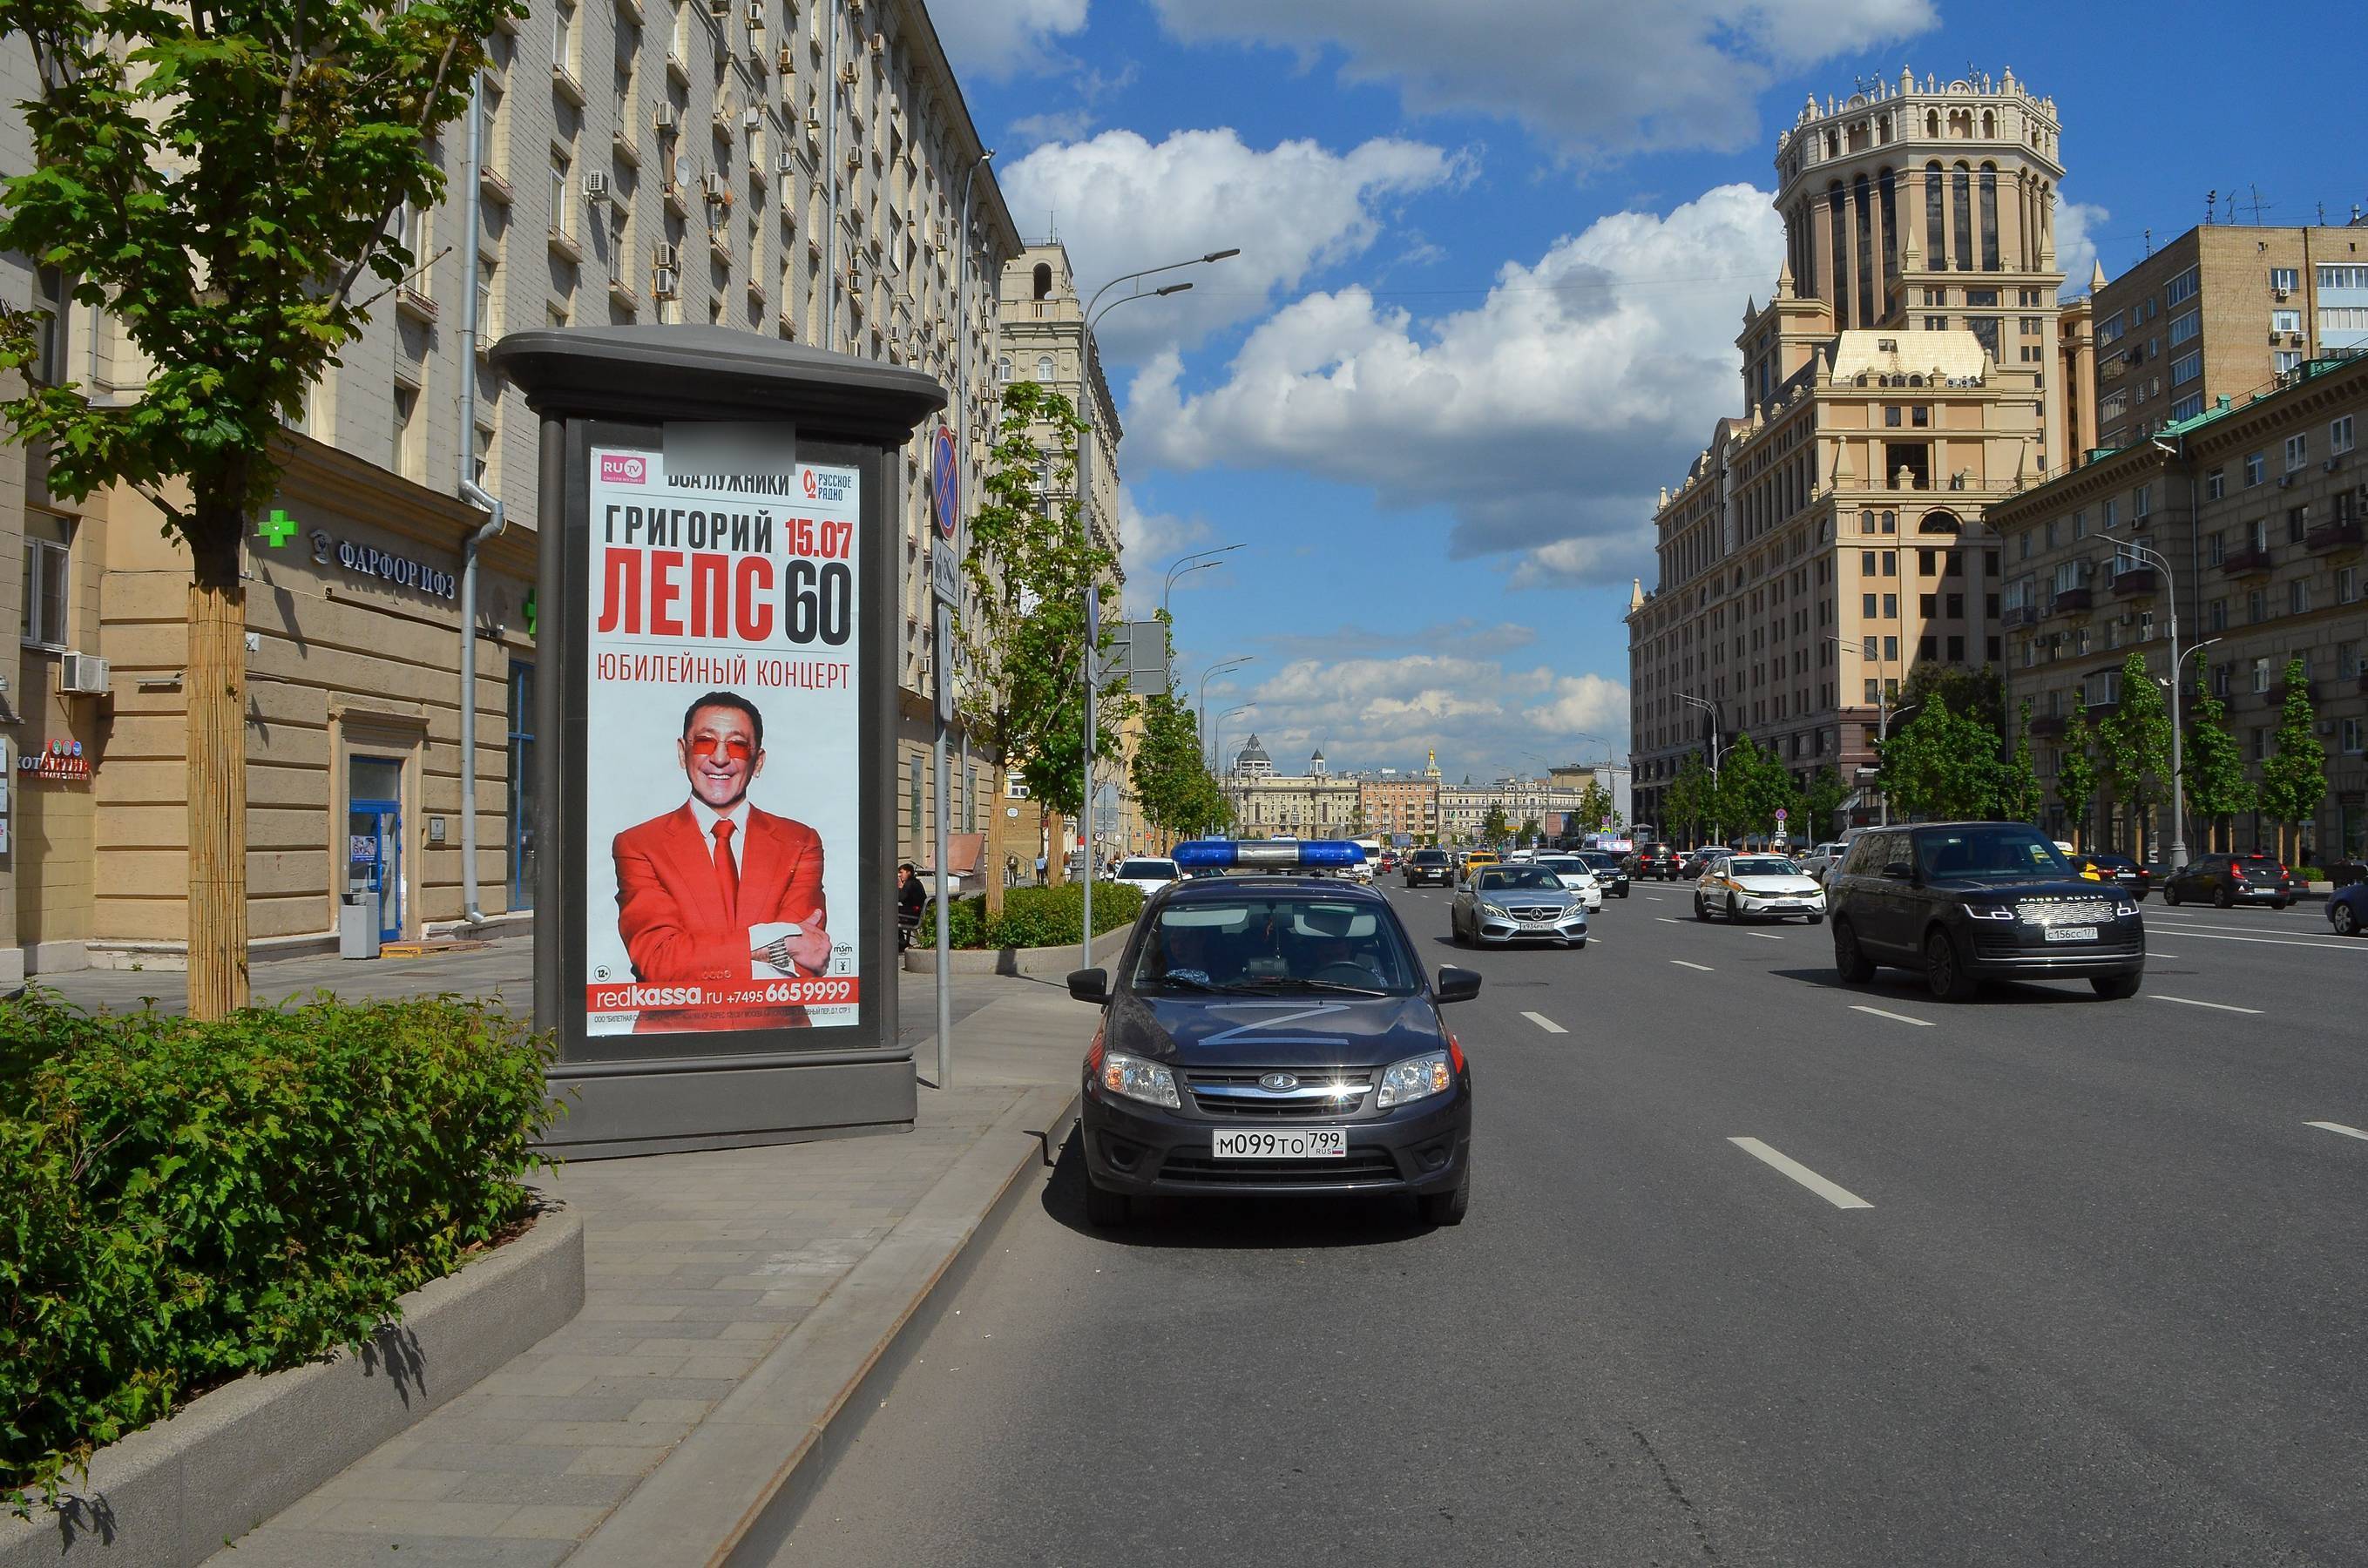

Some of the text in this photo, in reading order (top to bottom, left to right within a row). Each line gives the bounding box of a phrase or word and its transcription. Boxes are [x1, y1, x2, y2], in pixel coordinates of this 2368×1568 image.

[818, 473, 852, 488] РУССКОЕ
[605, 504, 773, 553] ГРИГОРИЙ
[785, 518, 853, 559] 15.07
[339, 540, 455, 600] ФАРФОР ИФЗ
[598, 547, 774, 642] ЛЕПС
[785, 559, 852, 645] 60
[598, 652, 850, 690] ЮБИЛЕЙНЫЙ КОНЦЕРТ
[597, 985, 722, 1008] redkassa.ru
[727, 990, 764, 1004] +7495
[1198, 1004, 1351, 1046] Z
[1309, 1132, 1340, 1149] 799
